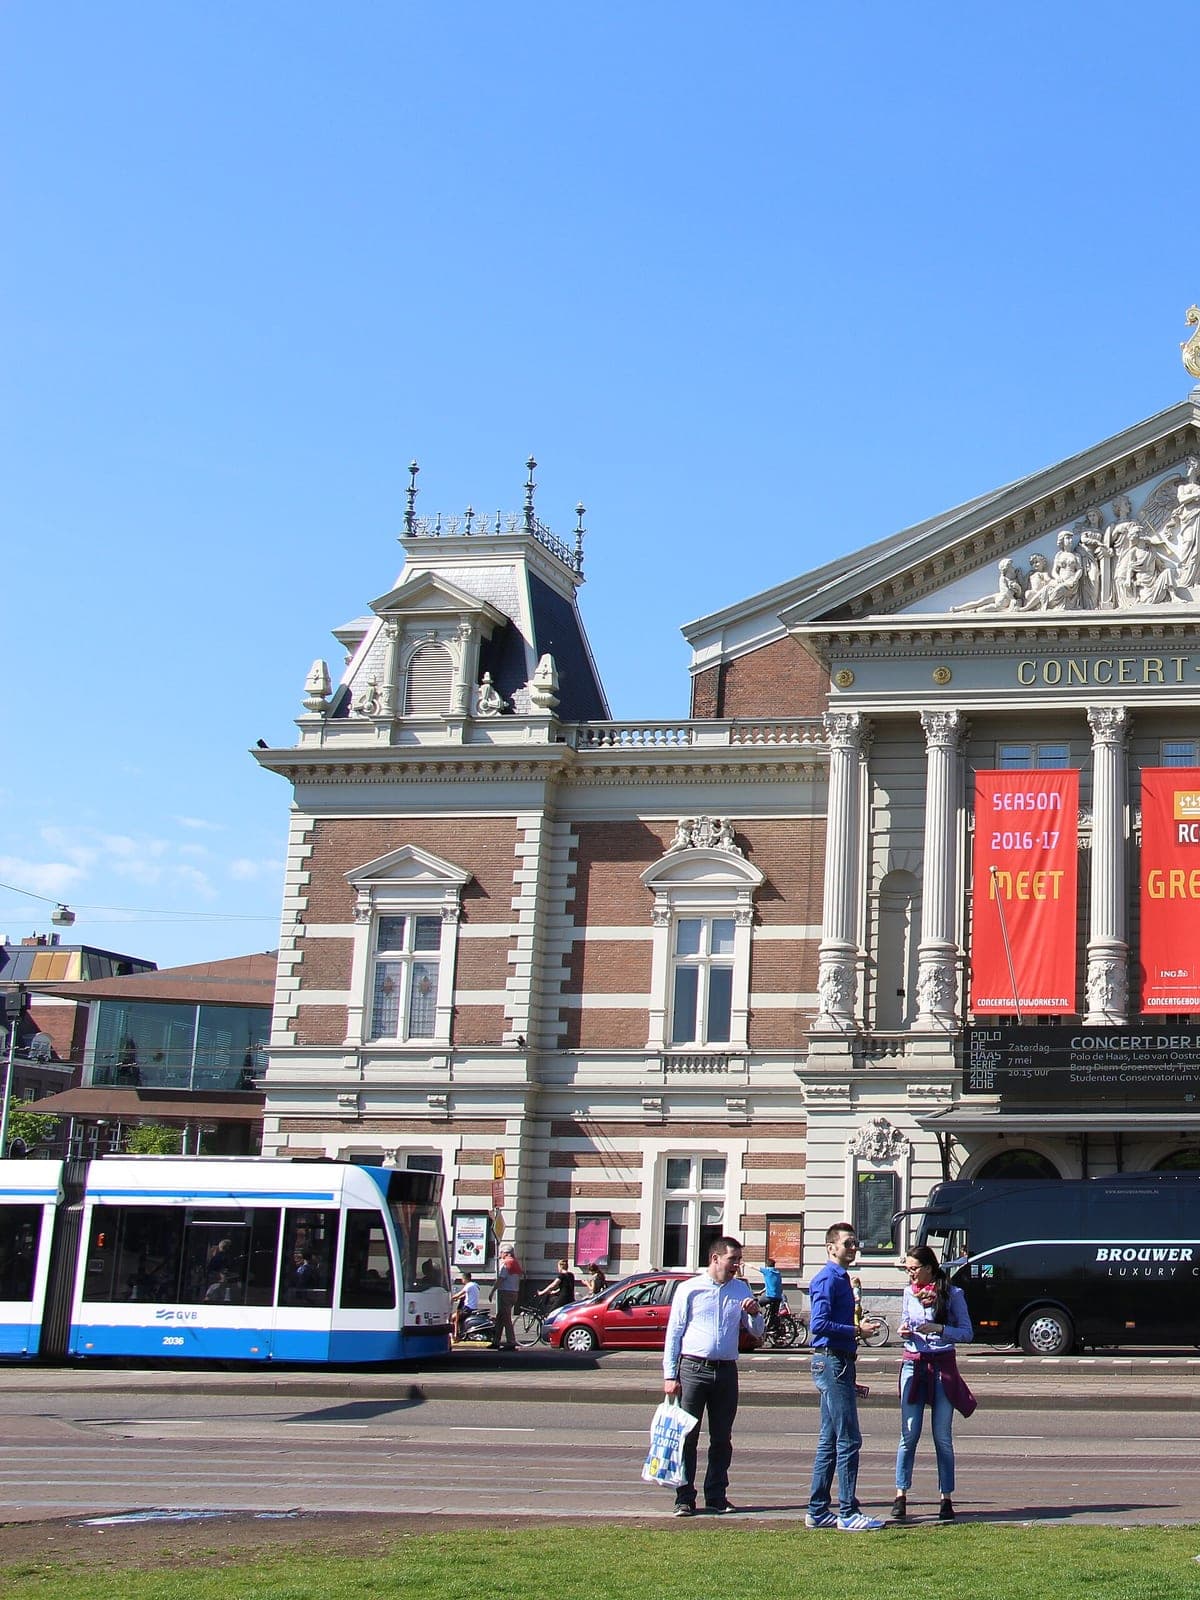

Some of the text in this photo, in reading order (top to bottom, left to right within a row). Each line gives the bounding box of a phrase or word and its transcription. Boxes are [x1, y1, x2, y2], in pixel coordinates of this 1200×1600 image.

[992, 792, 1062, 811] SEASON
[989, 870, 1065, 900] MEET
[1160, 970, 1177, 978] ING
[971, 1031, 1001, 1041] POLO
[970, 1041, 985, 1050] DE
[1071, 1036, 1153, 1050] CONCERT
[1157, 1035, 1191, 1049] DER
[1008, 1043, 1050, 1054] Zaterdag
[970, 1051, 1001, 1060] HAAS
[1070, 1053, 1091, 1061] Polo
[1092, 1053, 1104, 1061] de
[1106, 1053, 1130, 1061] Haas,
[970, 1060, 997, 1070] SERIE
[1008, 1056, 1032, 1066] 7 mei
[970, 1070, 997, 1079] 2015-
[1070, 1073, 1117, 1082] Studenten
[1119, 1073, 1192, 1082] Conservatorium
[970, 1079, 994, 1089] 2016
[1096, 1248, 1193, 1262] BROUWER
[1108, 1267, 1177, 1276] LUXURY
[176, 1311, 198, 1320] GVB
